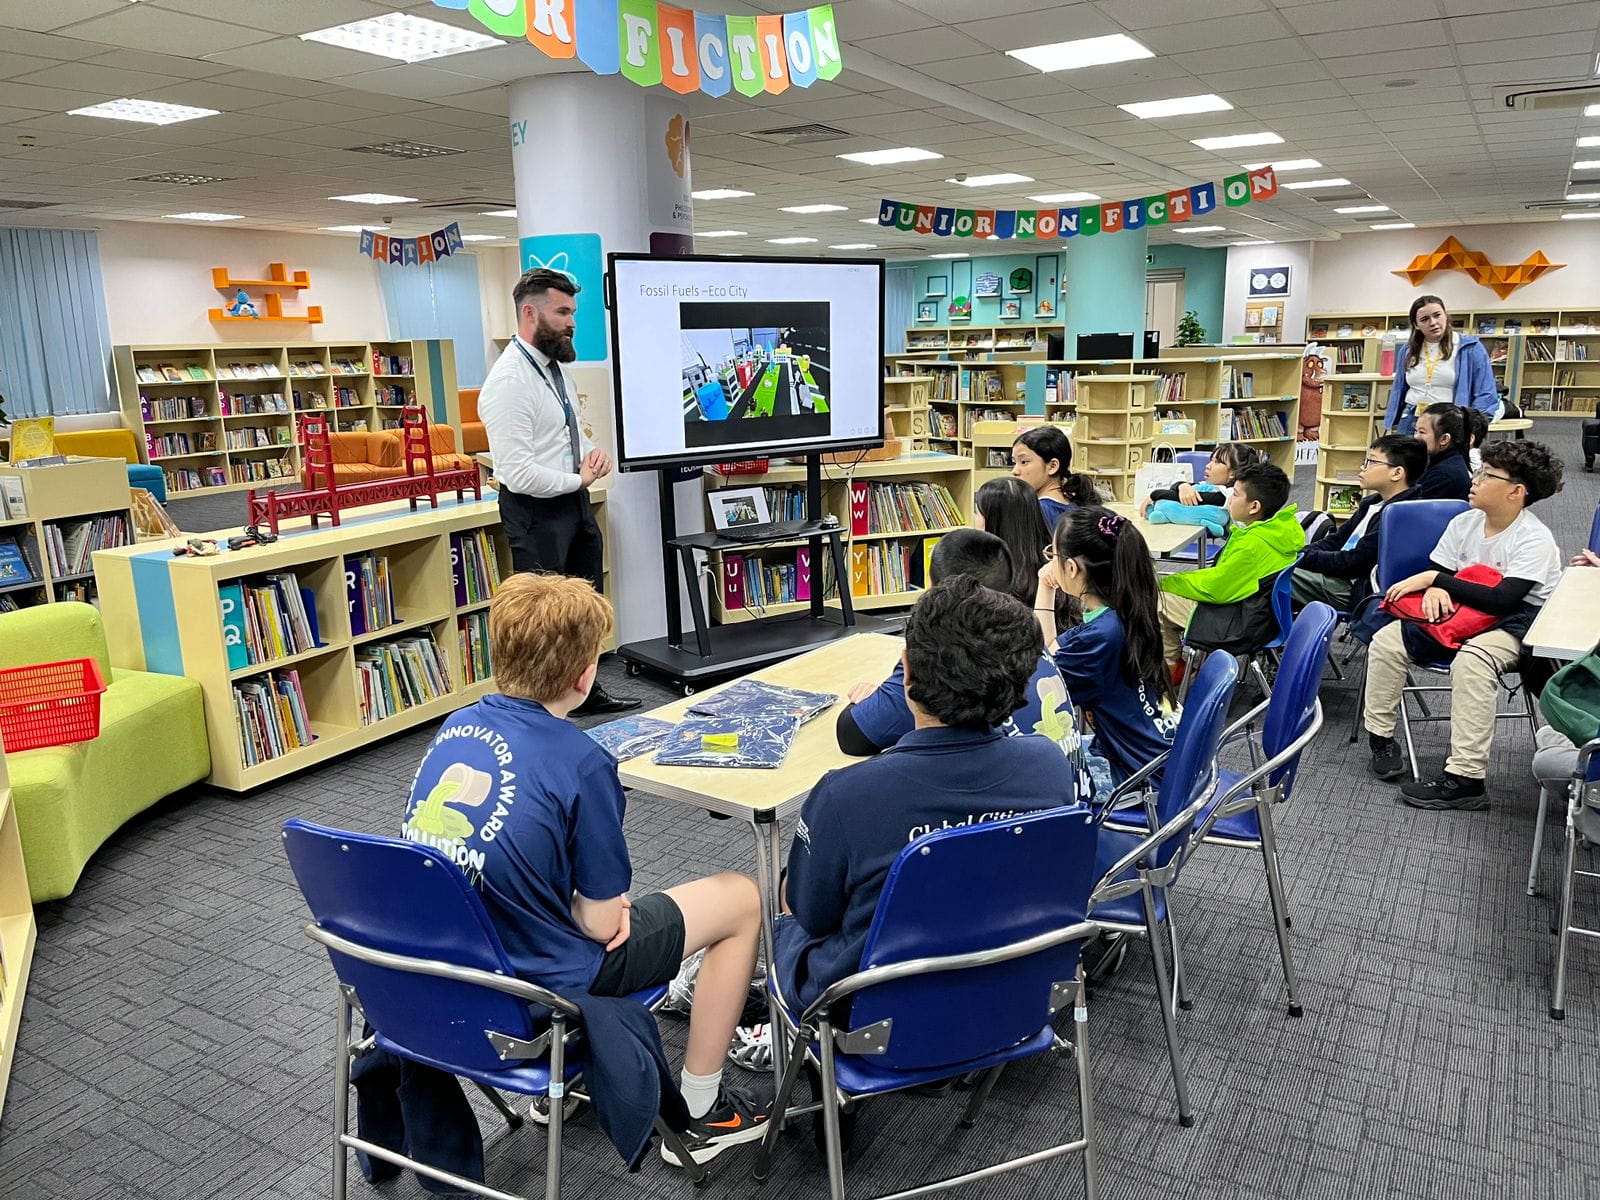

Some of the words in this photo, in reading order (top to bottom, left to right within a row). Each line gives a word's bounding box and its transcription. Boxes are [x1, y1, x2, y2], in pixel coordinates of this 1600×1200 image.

[622, 13, 839, 80] FICTION
[880, 206, 991, 234] JUNIOR
[362, 228, 461, 258] FICTION
[639, 284, 669, 297] Fossil
[672, 284, 700, 297] Fuels
[728, 285, 748, 299] City
[913, 390, 923, 405] W
[1131, 389, 1142, 407] L
[913, 417, 923, 435] S
[1130, 422, 1142, 439] M
[1128, 451, 1140, 470] P
[851, 489, 866, 504] W
[450, 547, 459, 565] S
[801, 554, 810, 567] V
[853, 551, 863, 565] Y
[727, 563, 738, 577] U
[345, 571, 356, 589] R
[220, 598, 235, 621] P
[224, 624, 242, 646] Q
[435, 724, 513, 767] INNOVATOR
[480, 769, 516, 842] AWARD
